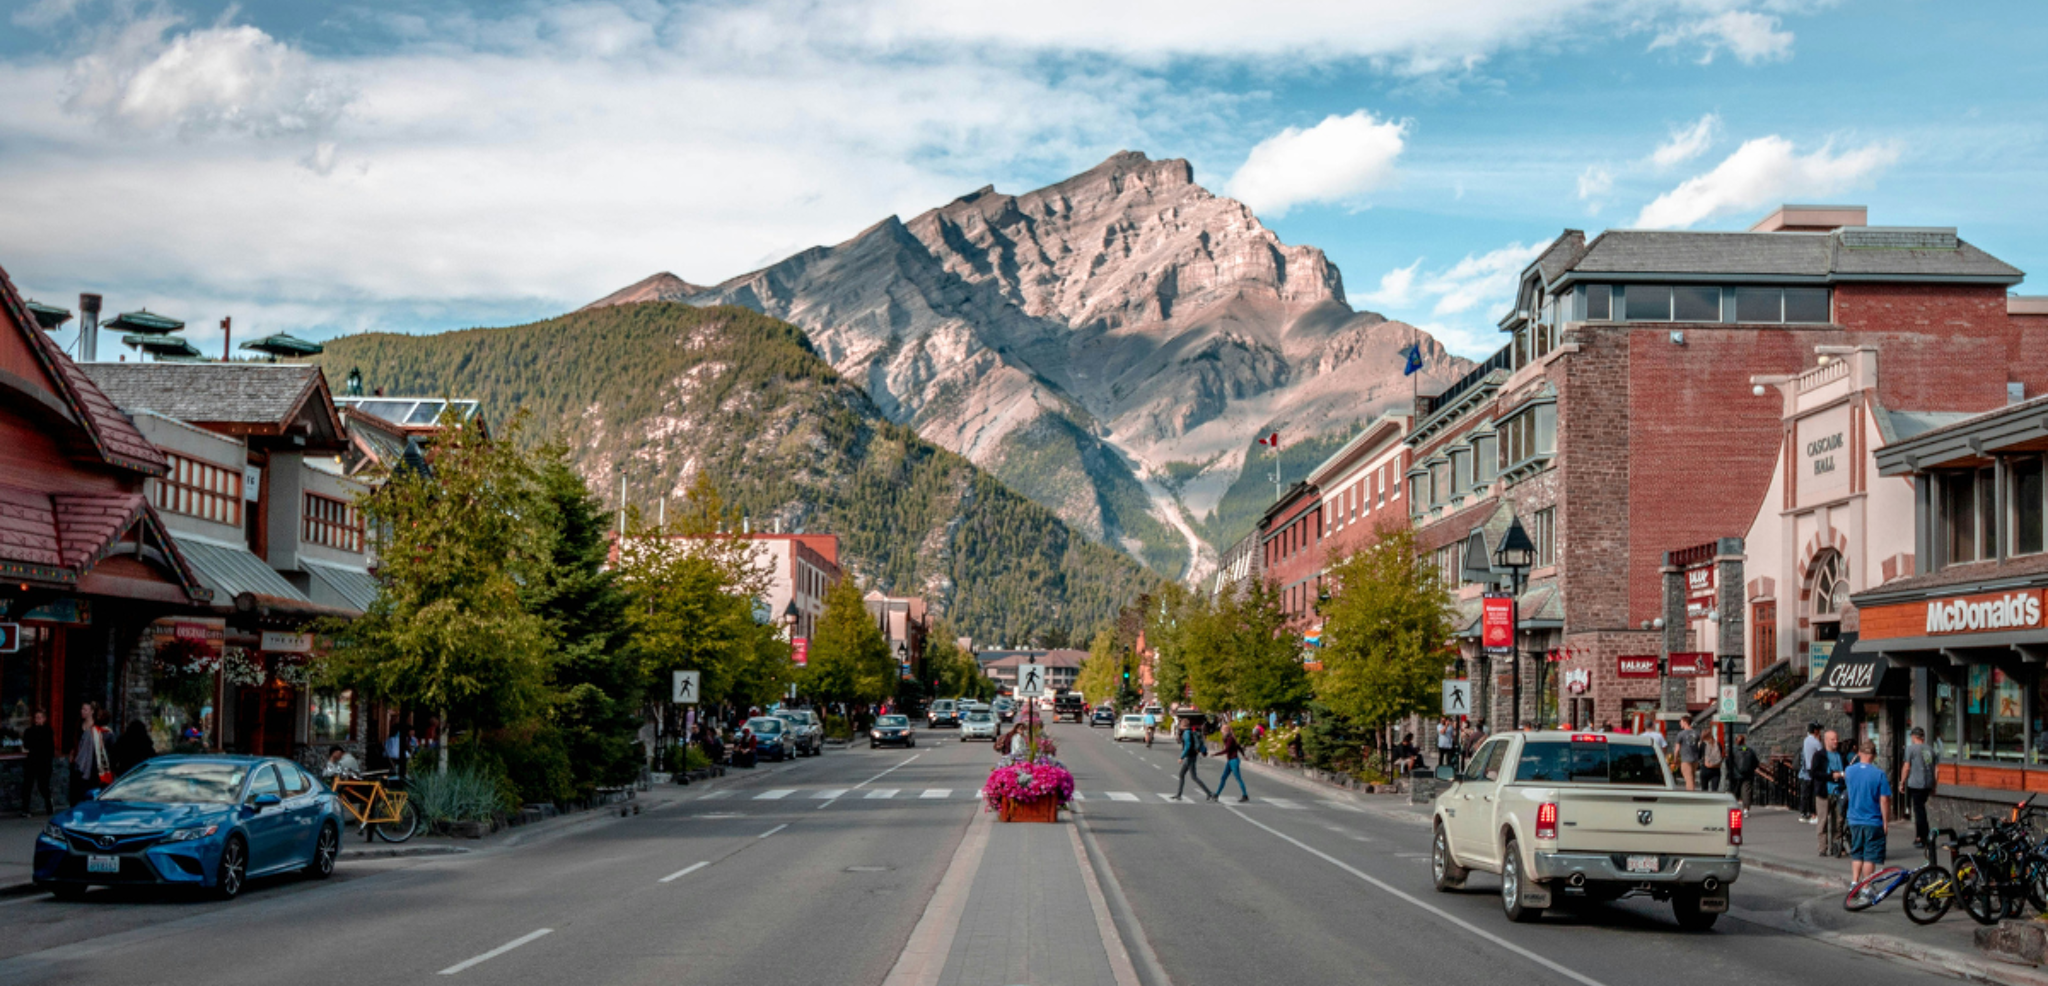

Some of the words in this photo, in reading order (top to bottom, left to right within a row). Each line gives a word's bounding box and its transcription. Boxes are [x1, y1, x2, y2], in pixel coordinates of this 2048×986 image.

[1807, 432, 1843, 457] CASCADE
[1814, 456, 1835, 475] HALL
[1926, 593, 2040, 632] McDonald's
[1829, 663, 1875, 687] CHAYA
